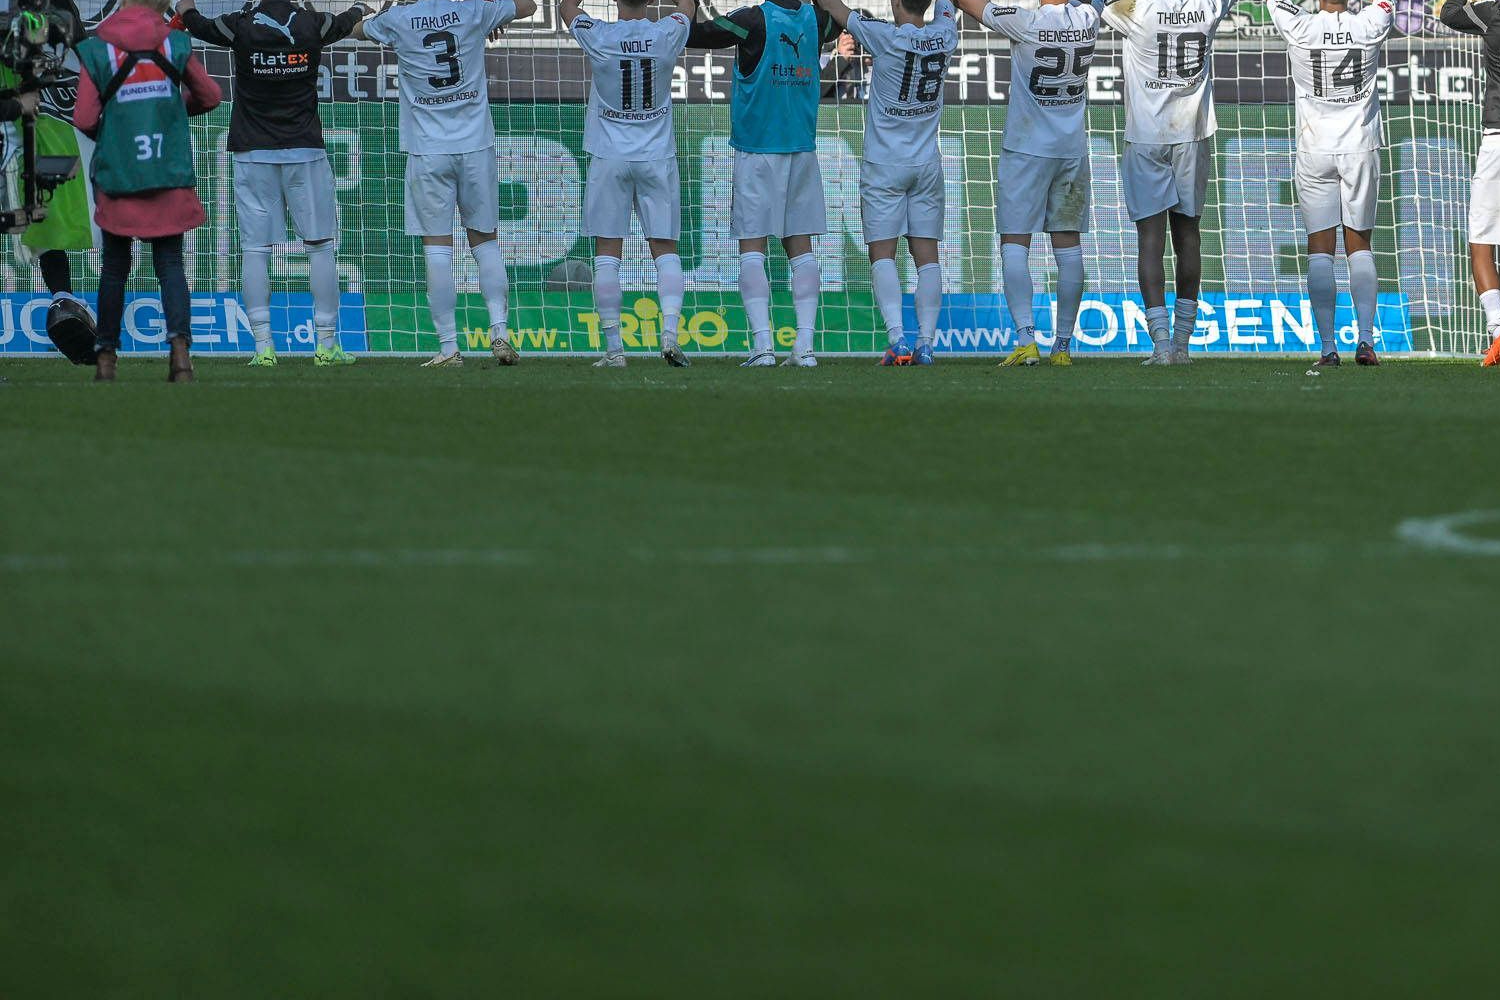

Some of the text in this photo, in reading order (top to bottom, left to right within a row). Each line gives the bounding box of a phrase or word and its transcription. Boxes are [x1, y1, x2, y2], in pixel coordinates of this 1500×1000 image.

[410, 10, 461, 31] ITAKURA
[1157, 10, 1206, 26] THURAM
[620, 39, 654, 54] WOLF
[1322, 31, 1354, 46] PLEA
[282, 65, 309, 76] yourself
[421, 30, 465, 92] 3
[1156, 32, 1211, 81] 10
[619, 57, 657, 113] 11
[897, 51, 949, 104] 18
[1028, 45, 1097, 100] 25
[1309, 48, 1368, 98] 14
[120, 85, 168, 98] BUNDESLIGA
[133, 133, 164, 161] 37
